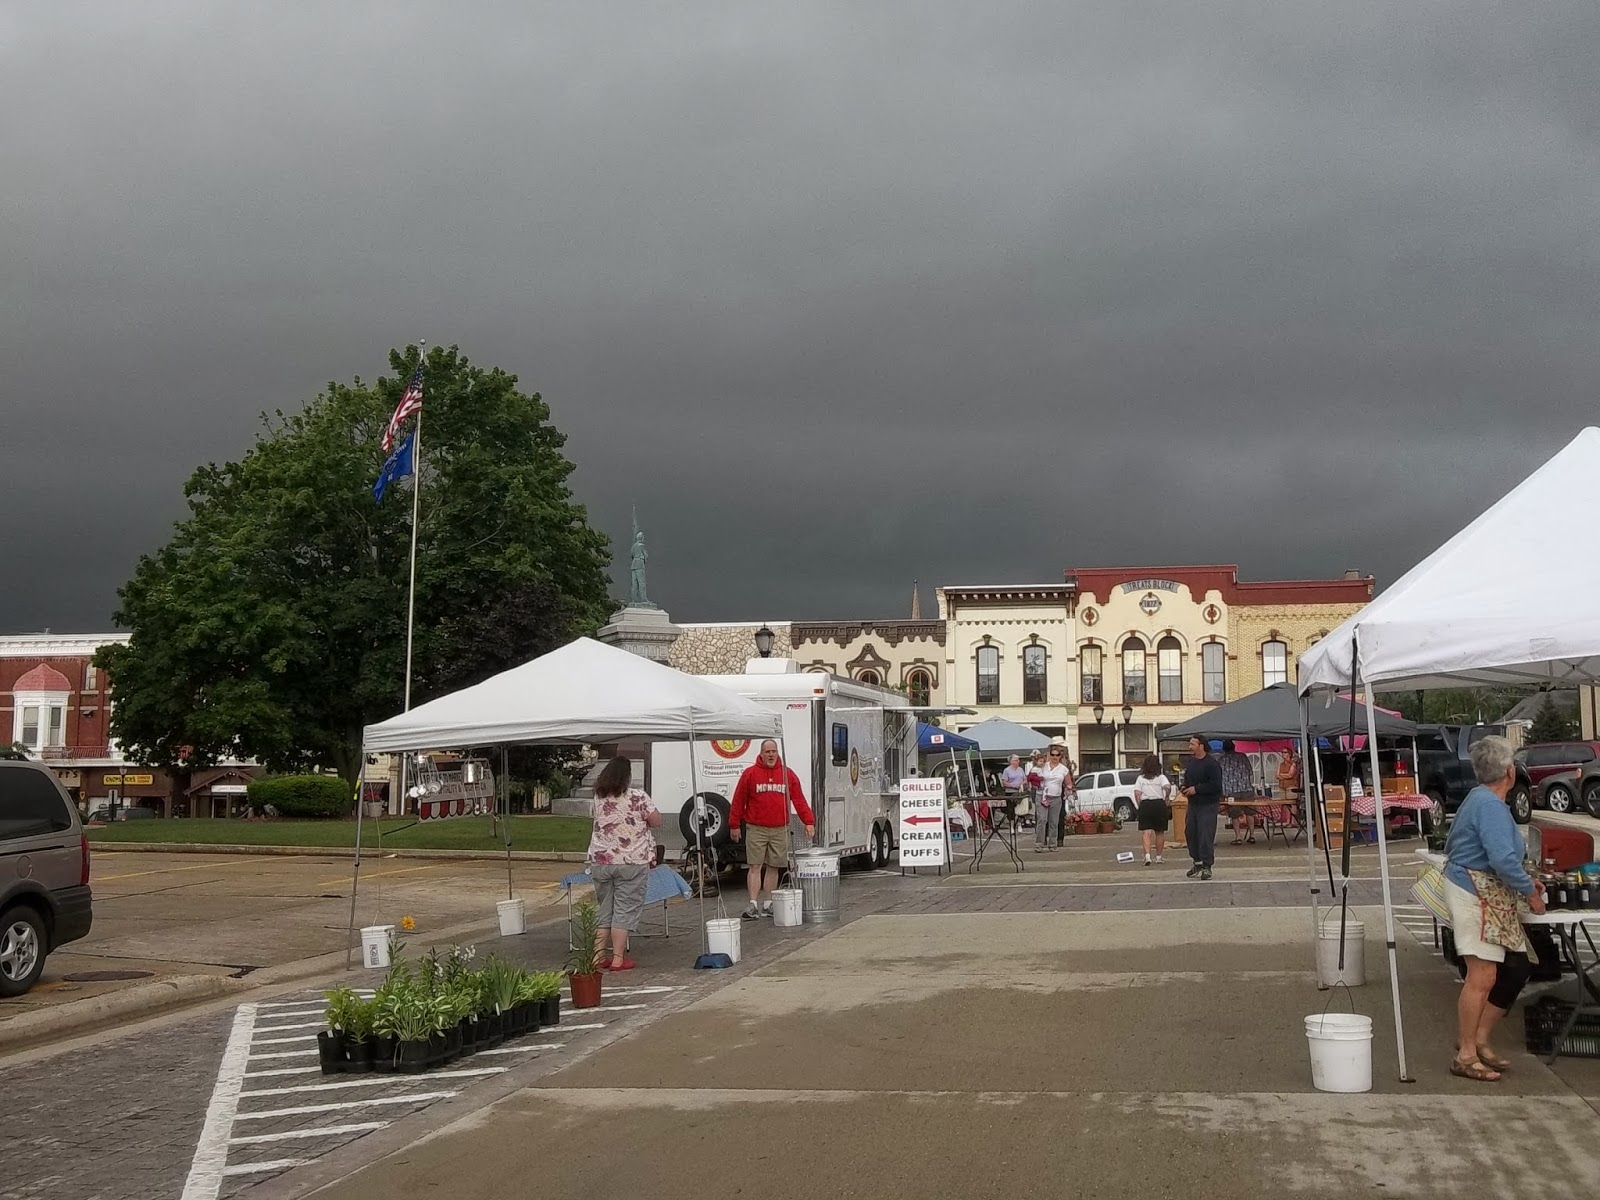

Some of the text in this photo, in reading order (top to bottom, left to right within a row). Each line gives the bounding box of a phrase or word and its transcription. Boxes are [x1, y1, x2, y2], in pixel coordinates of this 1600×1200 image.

[1128, 580, 1173, 590] TREATS BLOCK
[756, 783, 786, 793] MONROE
[901, 783, 942, 792] GRILLED
[901, 799, 942, 808] CHEESE
[901, 832, 942, 841] CREAM
[903, 848, 940, 857] PUFFS
